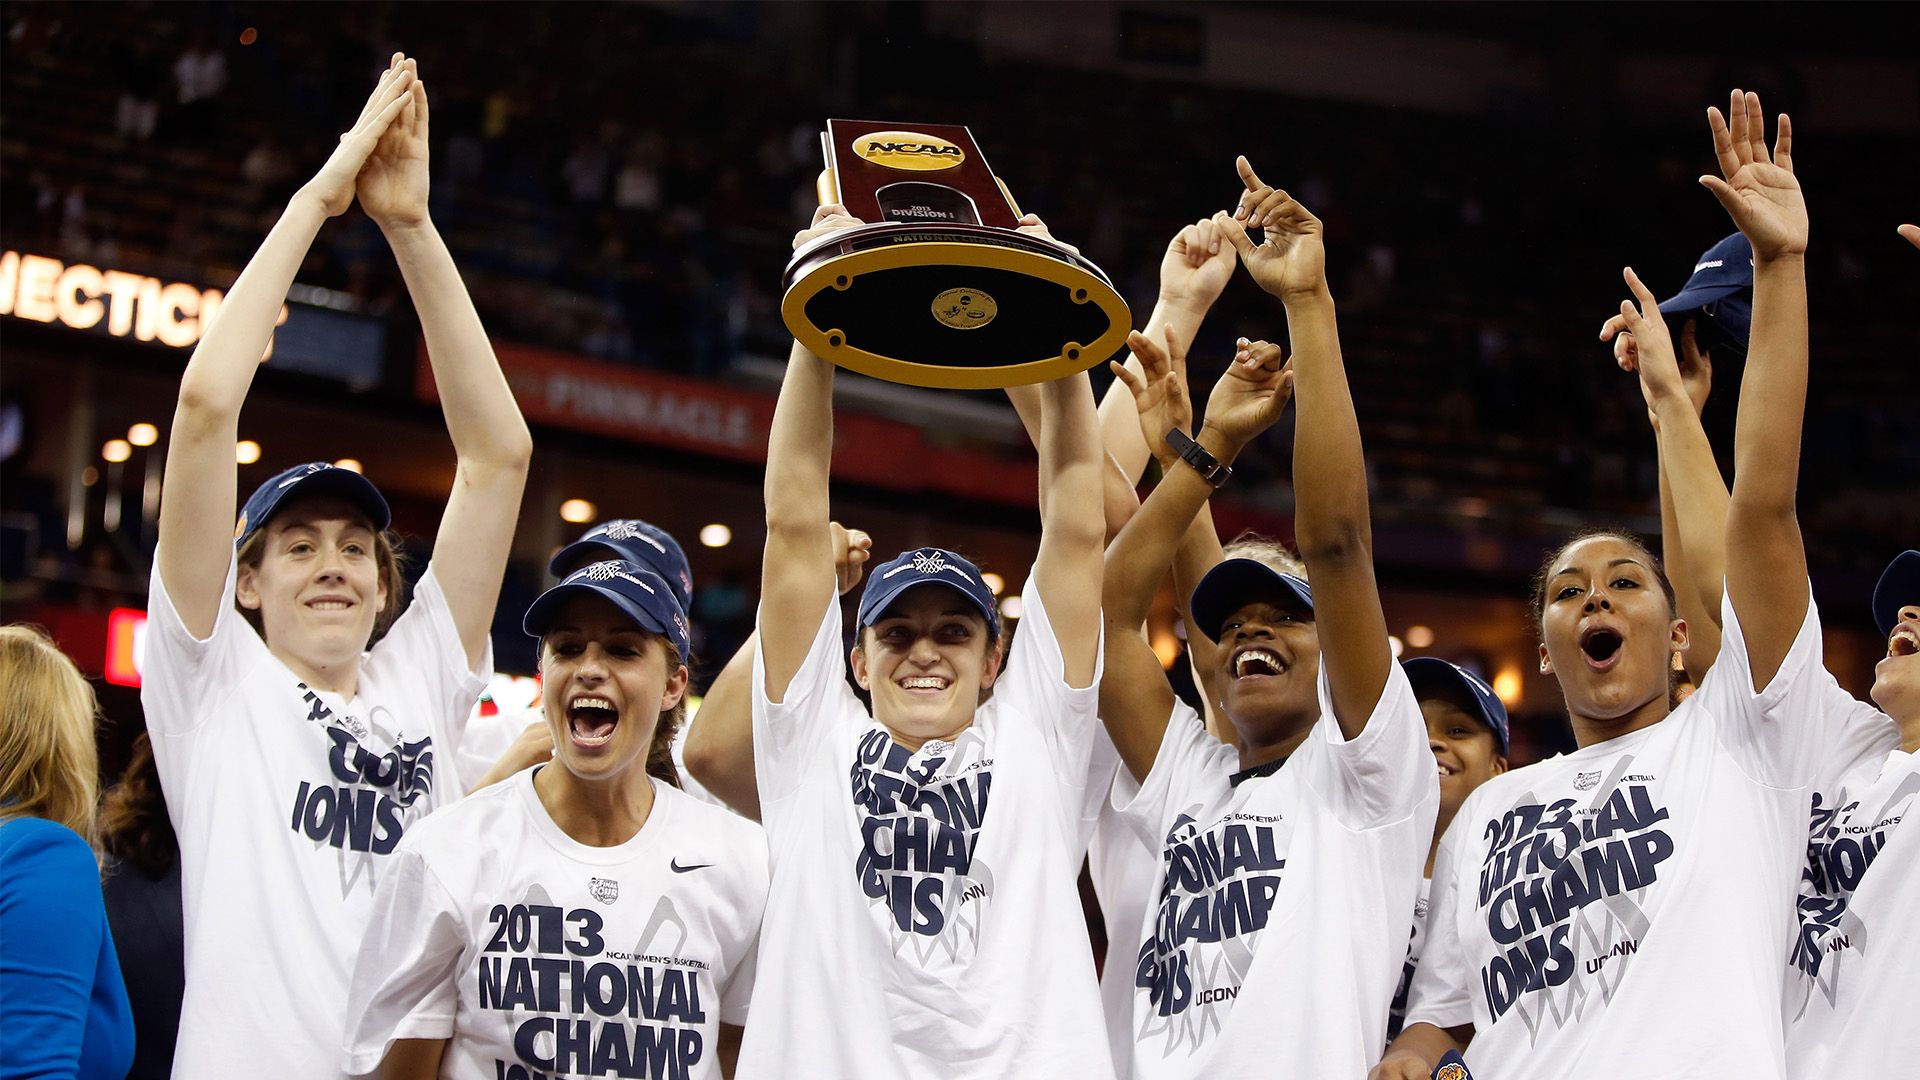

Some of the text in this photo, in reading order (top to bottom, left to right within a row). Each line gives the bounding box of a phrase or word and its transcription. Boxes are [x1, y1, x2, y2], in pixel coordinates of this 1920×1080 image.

[868, 141, 961, 157] NCAA
[892, 208, 947, 219] DIVISION
[893, 232, 960, 243] NATIONAL
[291, 780, 404, 855] IONS
[1483, 798, 1578, 867] 2013
[1488, 829, 1675, 945] CHAMP
[483, 903, 605, 957] 2013
[478, 956, 706, 1025] NATIONAL
[1195, 986, 1242, 1007] UCON
[1481, 923, 1576, 1026] IONS
[513, 1016, 703, 1080] CHAMP
